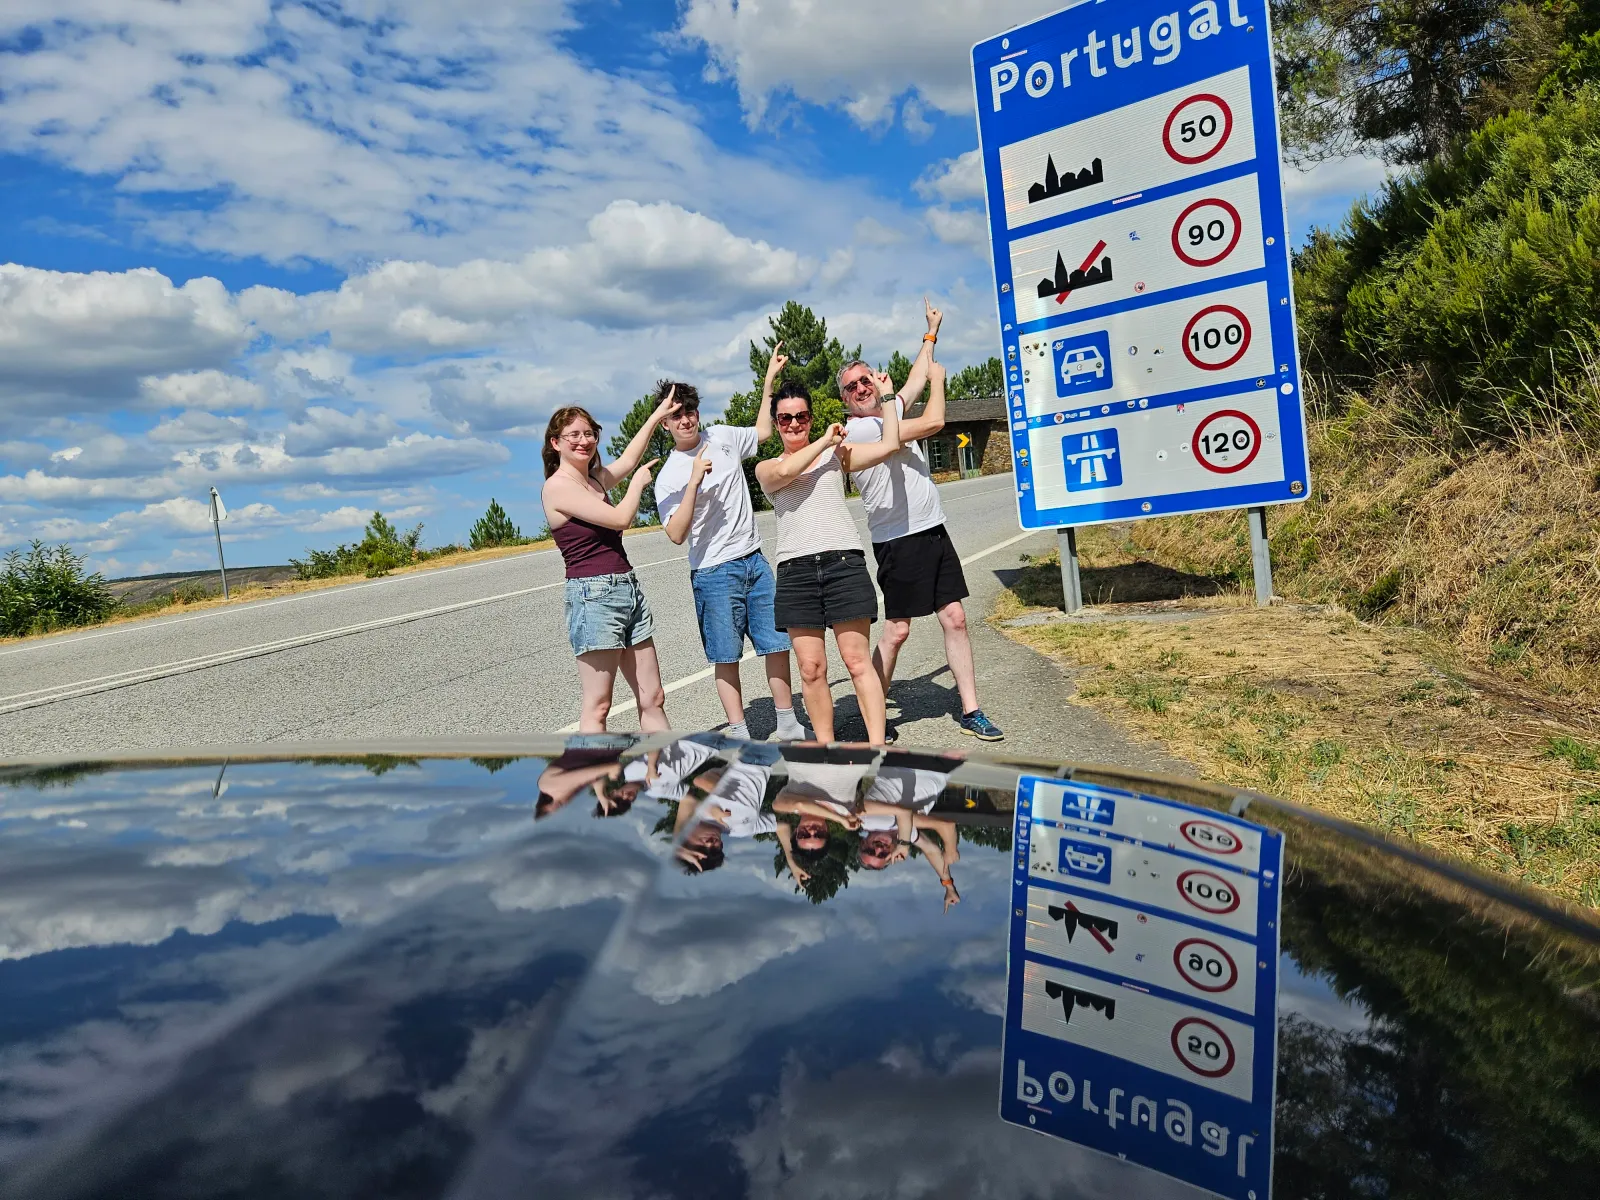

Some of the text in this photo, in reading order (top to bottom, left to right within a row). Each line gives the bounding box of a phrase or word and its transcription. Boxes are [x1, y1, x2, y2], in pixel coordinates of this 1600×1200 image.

[990, 0, 1249, 113] Portugal
[1180, 114, 1217, 143] 50
[1188, 219, 1225, 246] 90
[1190, 323, 1243, 352] 100
[1201, 429, 1251, 455] 120
